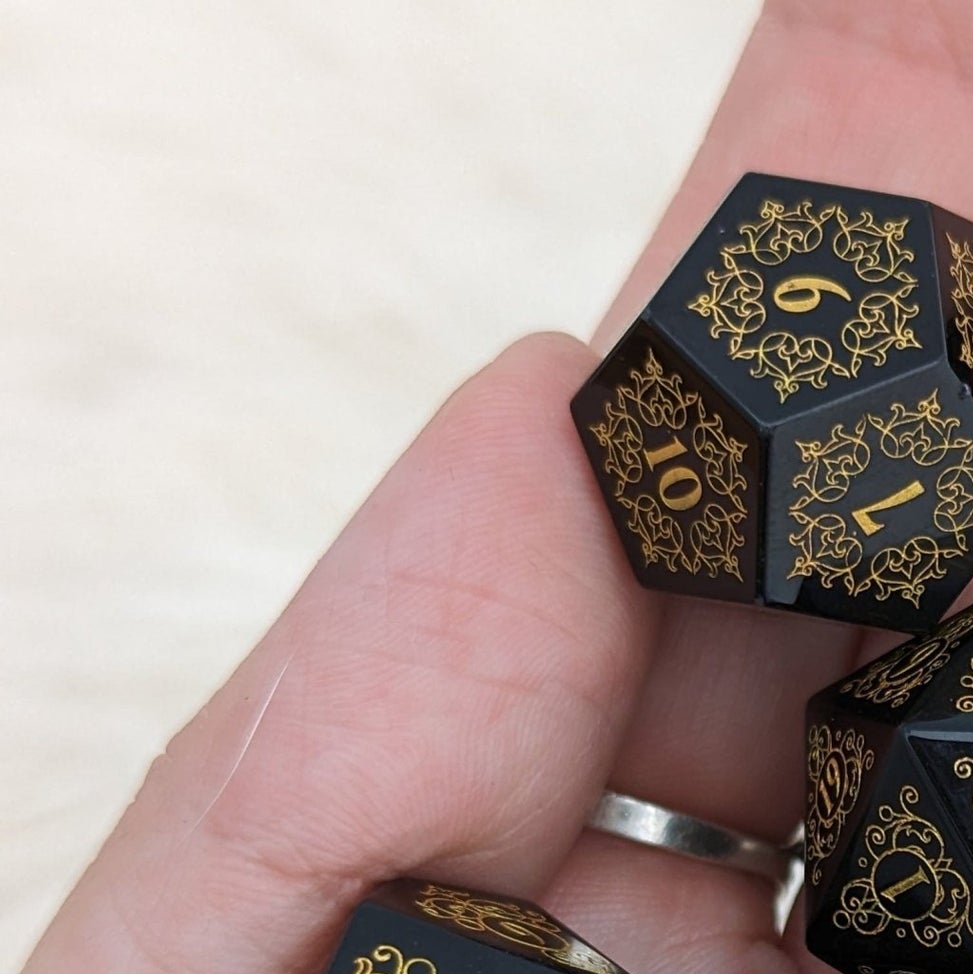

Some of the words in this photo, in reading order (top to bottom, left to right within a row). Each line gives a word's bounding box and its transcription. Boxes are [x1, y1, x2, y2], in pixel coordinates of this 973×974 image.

[644, 435, 703, 511] 10
[851, 480, 925, 537] 7
[818, 757, 841, 817] 19
[880, 865, 931, 904] 1
